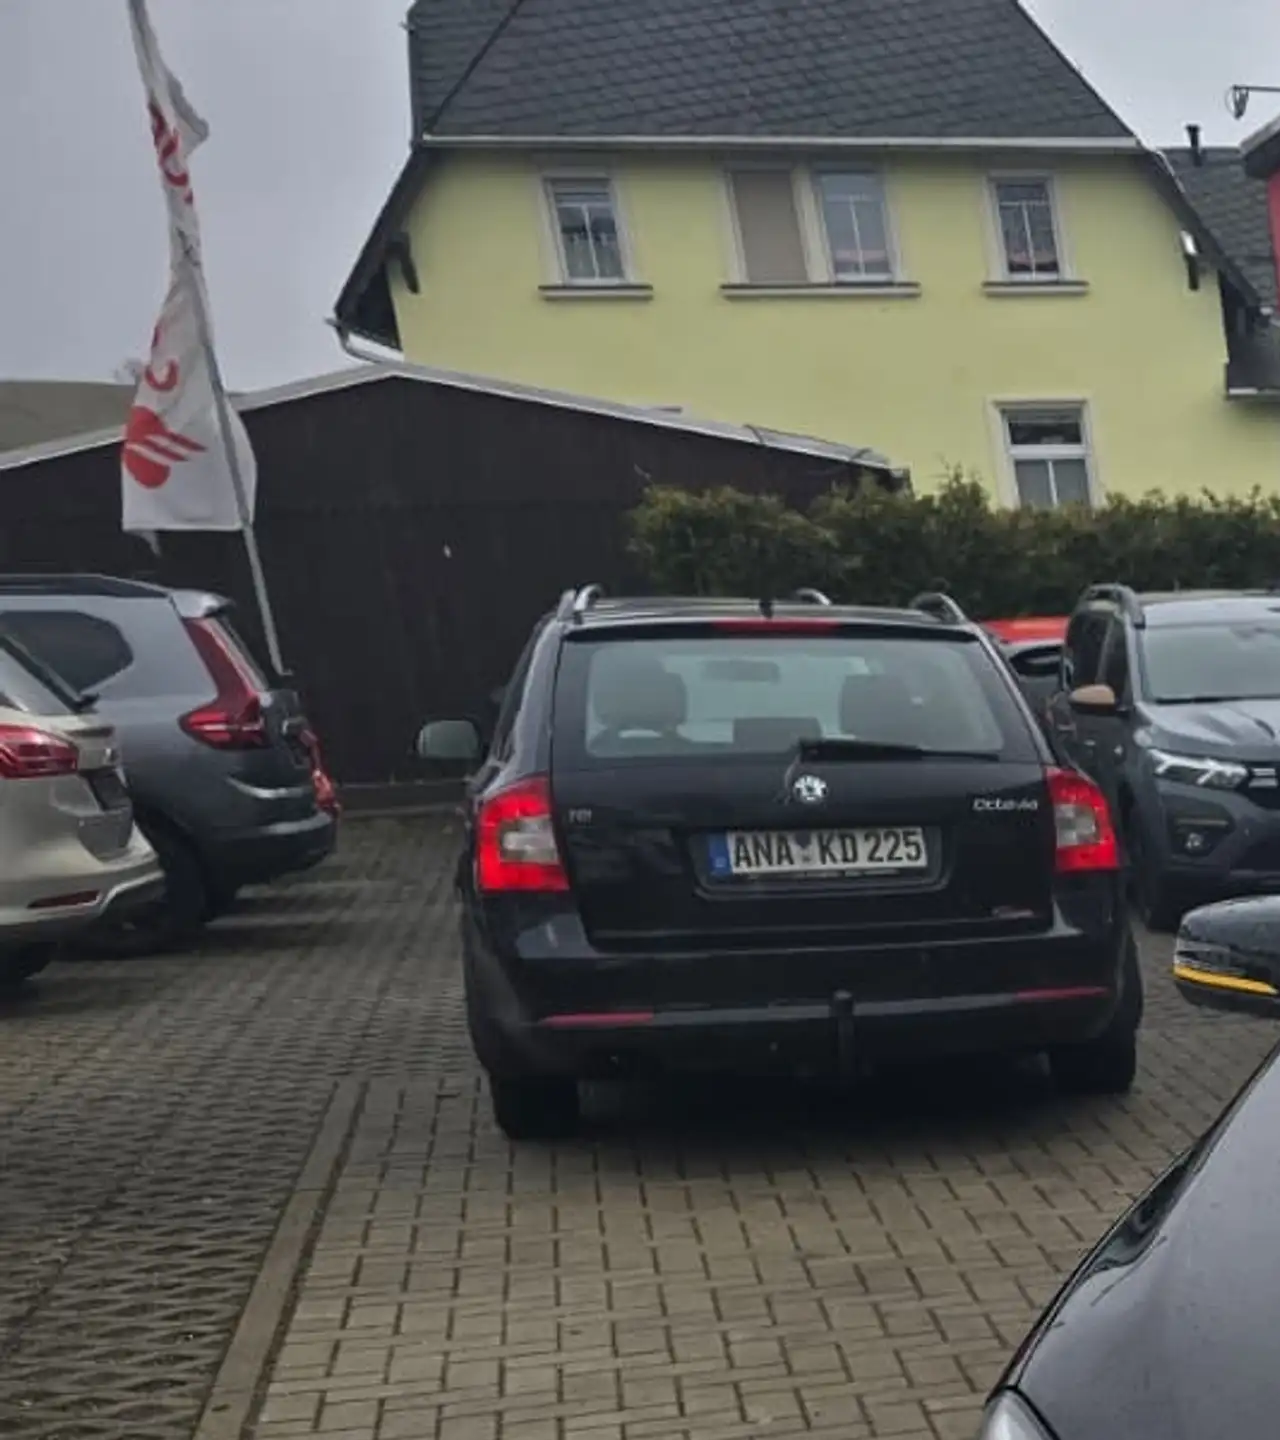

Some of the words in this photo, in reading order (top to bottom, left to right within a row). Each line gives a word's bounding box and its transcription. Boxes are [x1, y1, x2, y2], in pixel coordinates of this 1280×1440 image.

[733, 832, 795, 867] ANA
[817, 830, 858, 865] KD
[864, 828, 922, 863] 225
